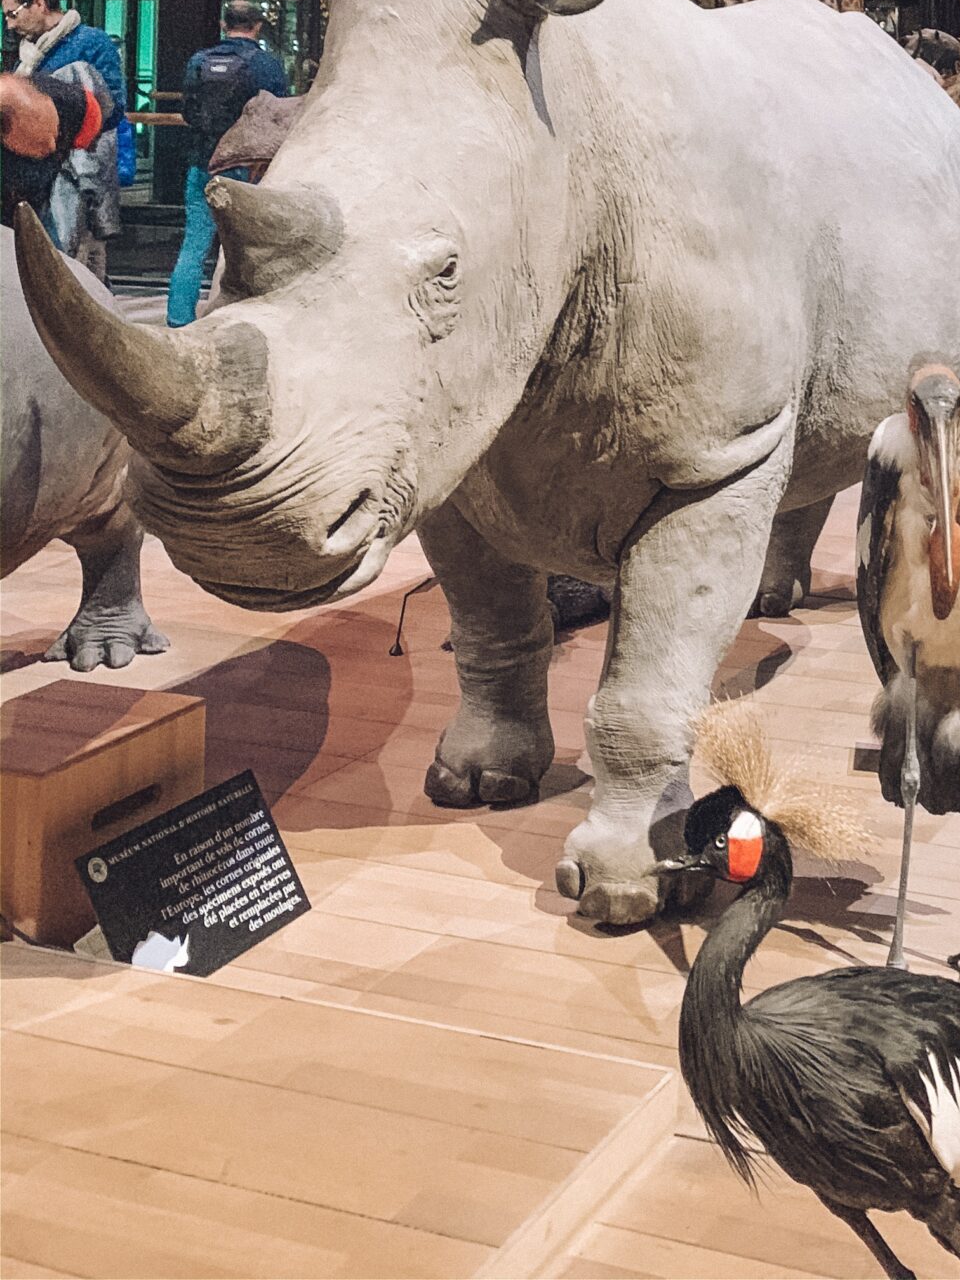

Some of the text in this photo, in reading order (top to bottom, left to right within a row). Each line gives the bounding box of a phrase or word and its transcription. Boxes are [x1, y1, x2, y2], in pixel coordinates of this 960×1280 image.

[141, 825, 177, 847] NATIONAL
[159, 858, 204, 888] important
[205, 852, 216, 863] de
[233, 836, 244, 847] de
[244, 822, 270, 841] cornes
[173, 810, 264, 864] En raison d'un nombre
[178, 834, 274, 894] de rhinocéros dans toute
[161, 845, 281, 920] l'Europe, les cornes originales
[182, 857, 286, 924] des spécimens exposés ont
[204, 869, 291, 927] été placées en réserves
[229, 881, 296, 928] et remplacées par
[249, 894, 302, 931] des moulages.
